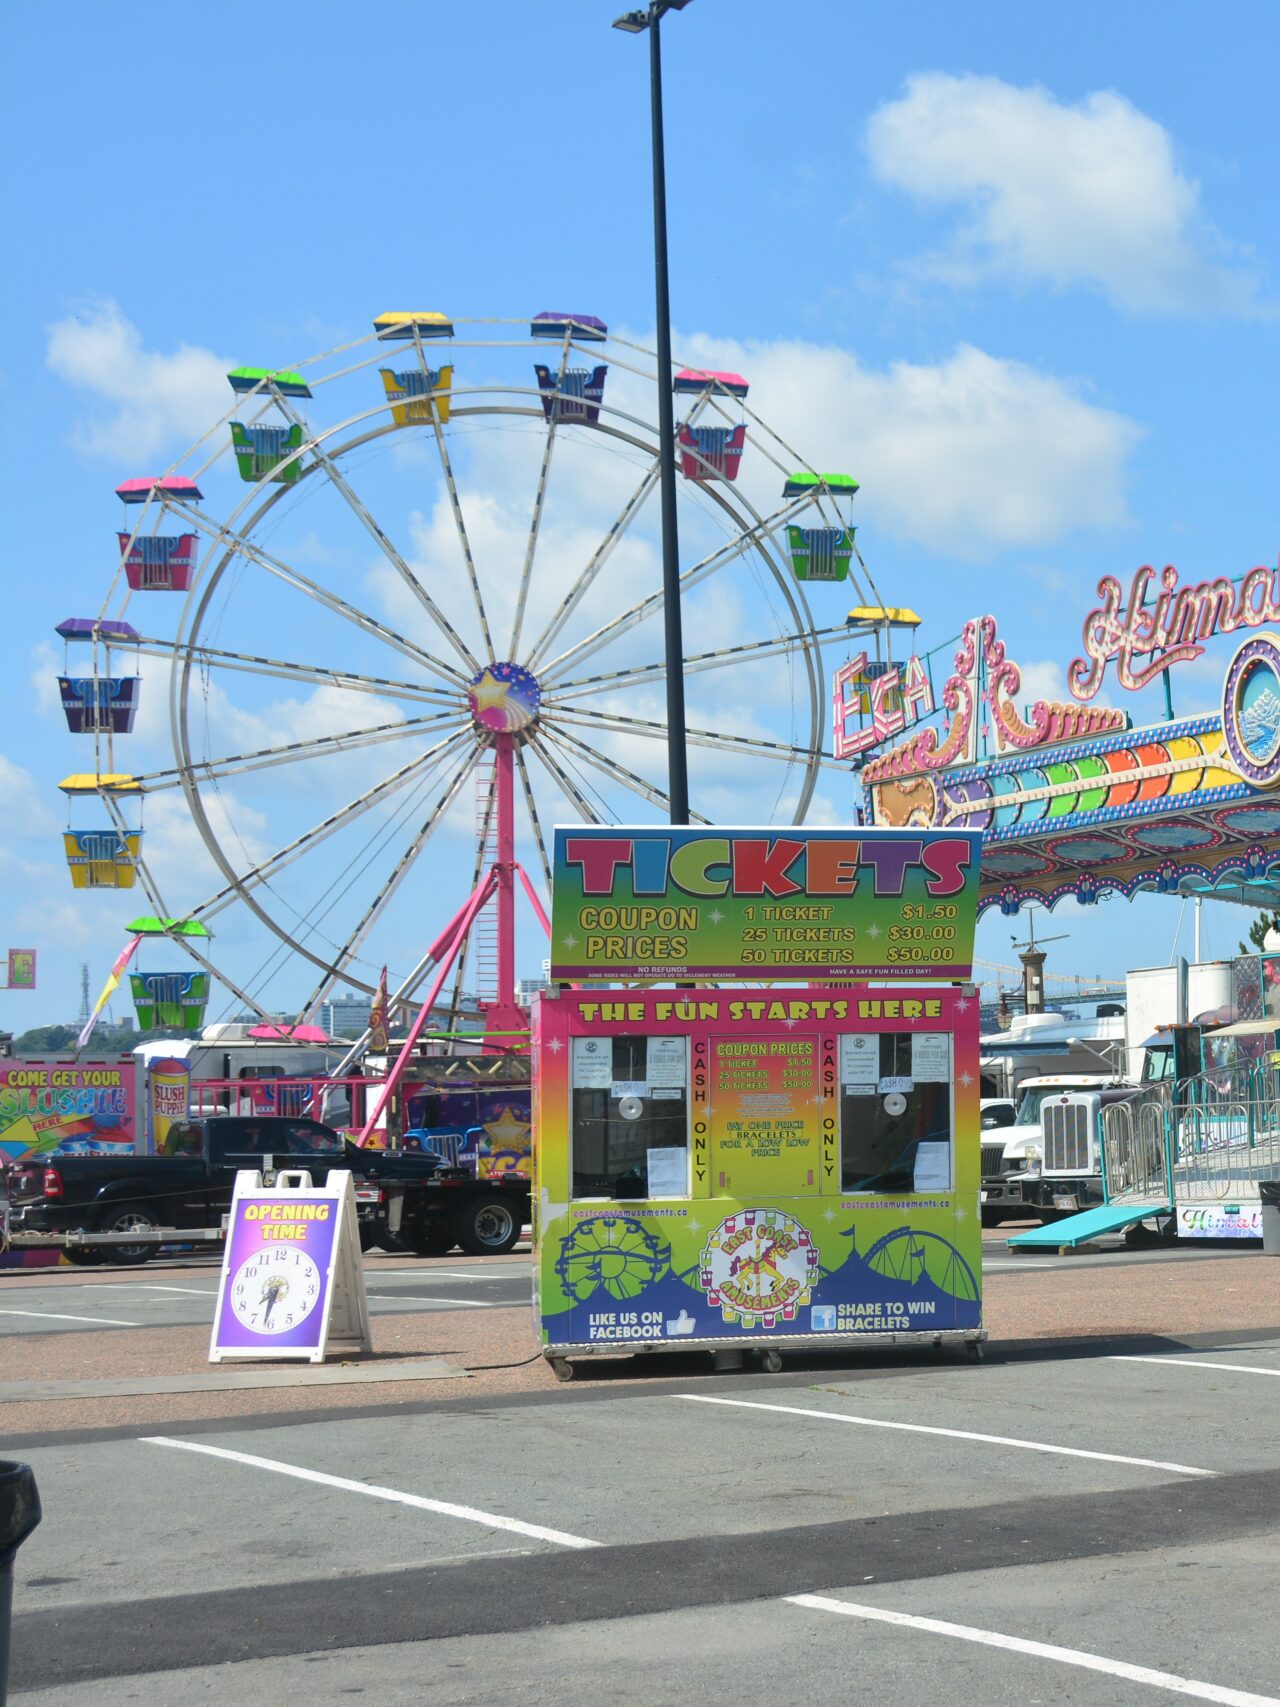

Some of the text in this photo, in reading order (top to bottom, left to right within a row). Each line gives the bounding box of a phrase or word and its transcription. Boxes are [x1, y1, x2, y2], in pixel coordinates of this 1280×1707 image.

[833, 651, 936, 760] ECA
[565, 837, 972, 900] TICKETS
[579, 906, 698, 931] COUPON
[744, 904, 957, 921] 1 TICKET $1.50
[741, 925, 956, 942] 25 TICKETS $30.00
[586, 935, 688, 960] PRICES
[740, 946, 955, 963] 50 TICKETS $50.00
[578, 998, 942, 1022] THE FUN STARTS HERE
[717, 1042, 813, 1057] COUPON PRICES
[727, 1060, 758, 1068] TICKET
[788, 1059, 812, 1067] $1.50
[823, 1039, 834, 1098] CASH
[7, 1070, 121, 1087] COME GET YOUR
[694, 1042, 706, 1102] CASH
[719, 1069, 812, 1079] 25 TICKETS $30.00
[154, 1084, 185, 1102] SLUSH
[733, 1082, 769, 1090] TICKETS
[0, 1087, 128, 1116] SLUSHIE
[32, 1116, 64, 1132] HERE
[727, 1120, 804, 1130] PAY ONE PRICE
[736, 1130, 796, 1139] BRACELETS
[720, 1138, 810, 1149] FOR A LOW LOW
[823, 1118, 835, 1177] ONLY
[694, 1122, 707, 1182] ONLY
[751, 1148, 781, 1157] PRICE
[841, 1200, 950, 1209] eastcoastamusements.ca
[244, 1204, 329, 1221] OPENING
[573, 1209, 688, 1218] eastcoastamusements.ca
[1182, 1207, 1263, 1231] Himal
[260, 1223, 308, 1241] TIME
[721, 1224, 799, 1256] EAST COAST
[258, 1254, 270, 1265] 11
[274, 1250, 287, 1261] 12
[294, 1254, 300, 1265] 1
[244, 1267, 257, 1278] 10
[305, 1267, 312, 1277] 2
[236, 1284, 244, 1295] 9
[307, 1284, 314, 1295] 3
[719, 1278, 800, 1310] AMUSEMENTS
[239, 1301, 246, 1312] 8
[300, 1302, 307, 1311] 4
[837, 1301, 936, 1316] SHARE TO WIN
[251, 1313, 258, 1324] 7
[267, 1319, 274, 1330] 6
[285, 1313, 293, 1324] 5
[589, 1311, 663, 1326] LIKE US ON
[837, 1316, 910, 1330] BRACELETS
[589, 1325, 662, 1339] FACEBOOK
